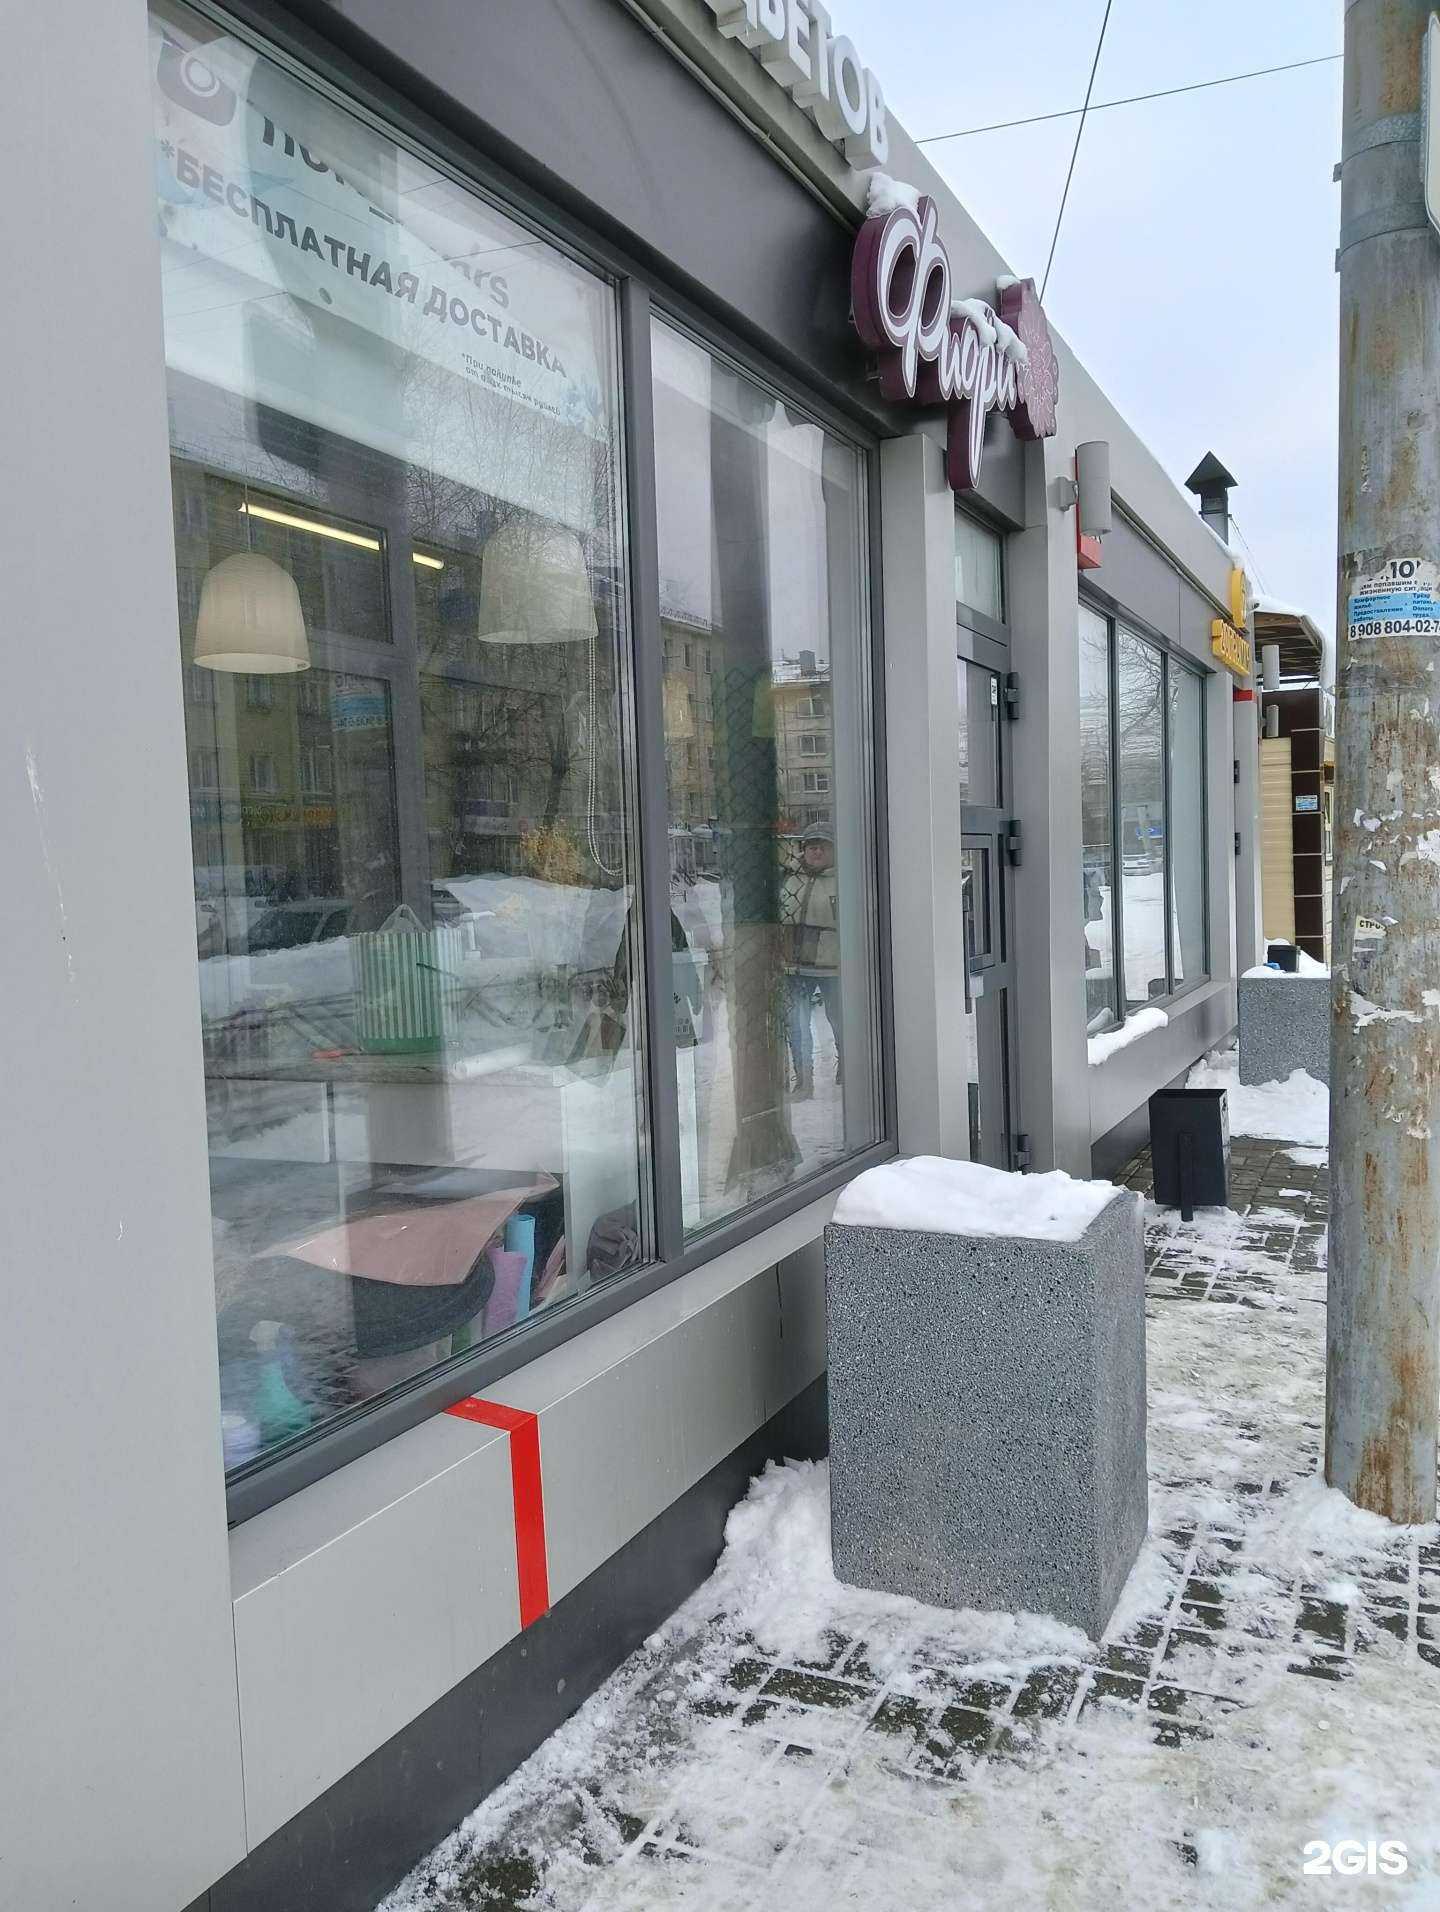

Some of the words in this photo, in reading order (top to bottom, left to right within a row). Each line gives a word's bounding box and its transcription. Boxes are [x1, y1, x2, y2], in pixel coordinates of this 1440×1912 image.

[423, 285, 567, 378] ДОСТАВКА
[1350, 624, 1356, 638] 8
[1358, 622, 1382, 636] 908
[1384, 620, 1440, 634] 804-02-7
